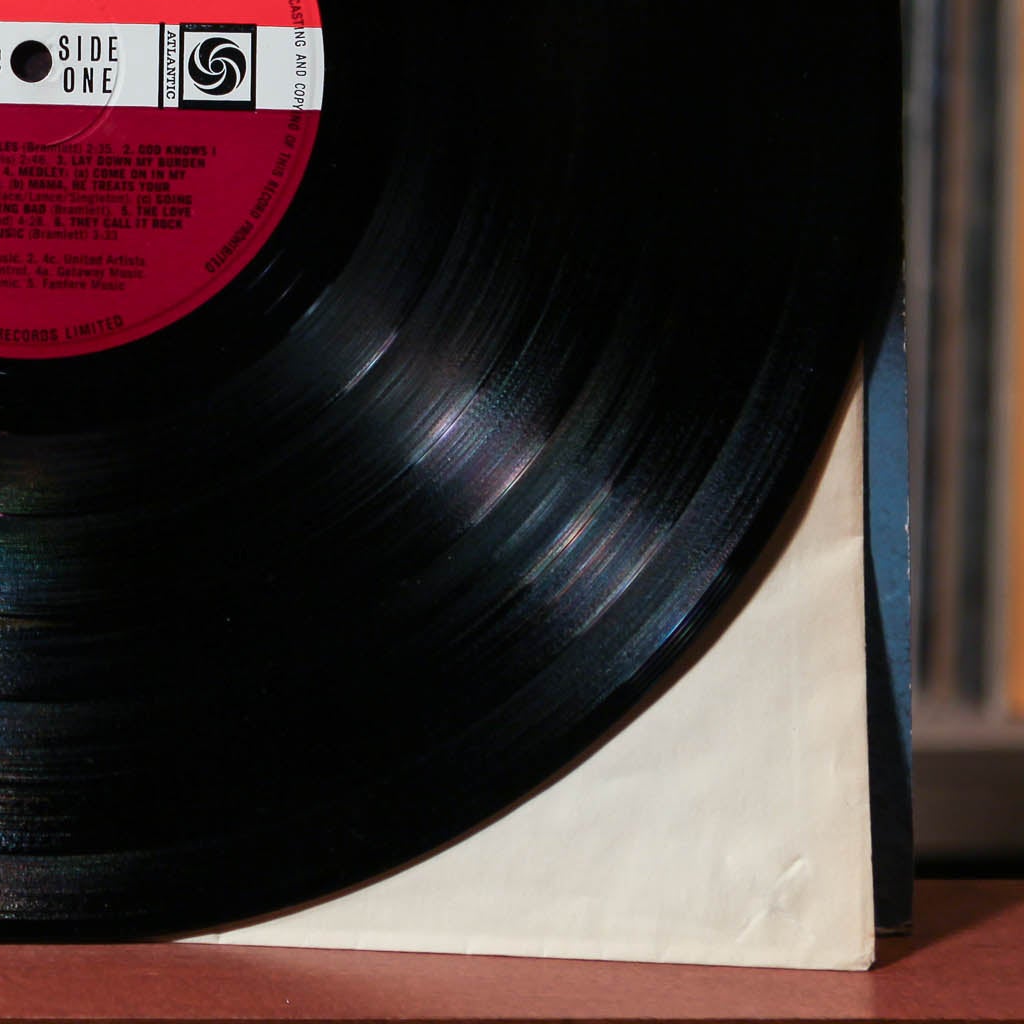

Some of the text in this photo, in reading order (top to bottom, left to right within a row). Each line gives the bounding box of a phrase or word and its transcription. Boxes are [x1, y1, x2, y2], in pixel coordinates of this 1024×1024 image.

[58, 35, 118, 62] SIDE
[166, 30, 176, 100] ATLANTIC
[295, 53, 307, 76] AND
[63, 67, 112, 94] ONE
